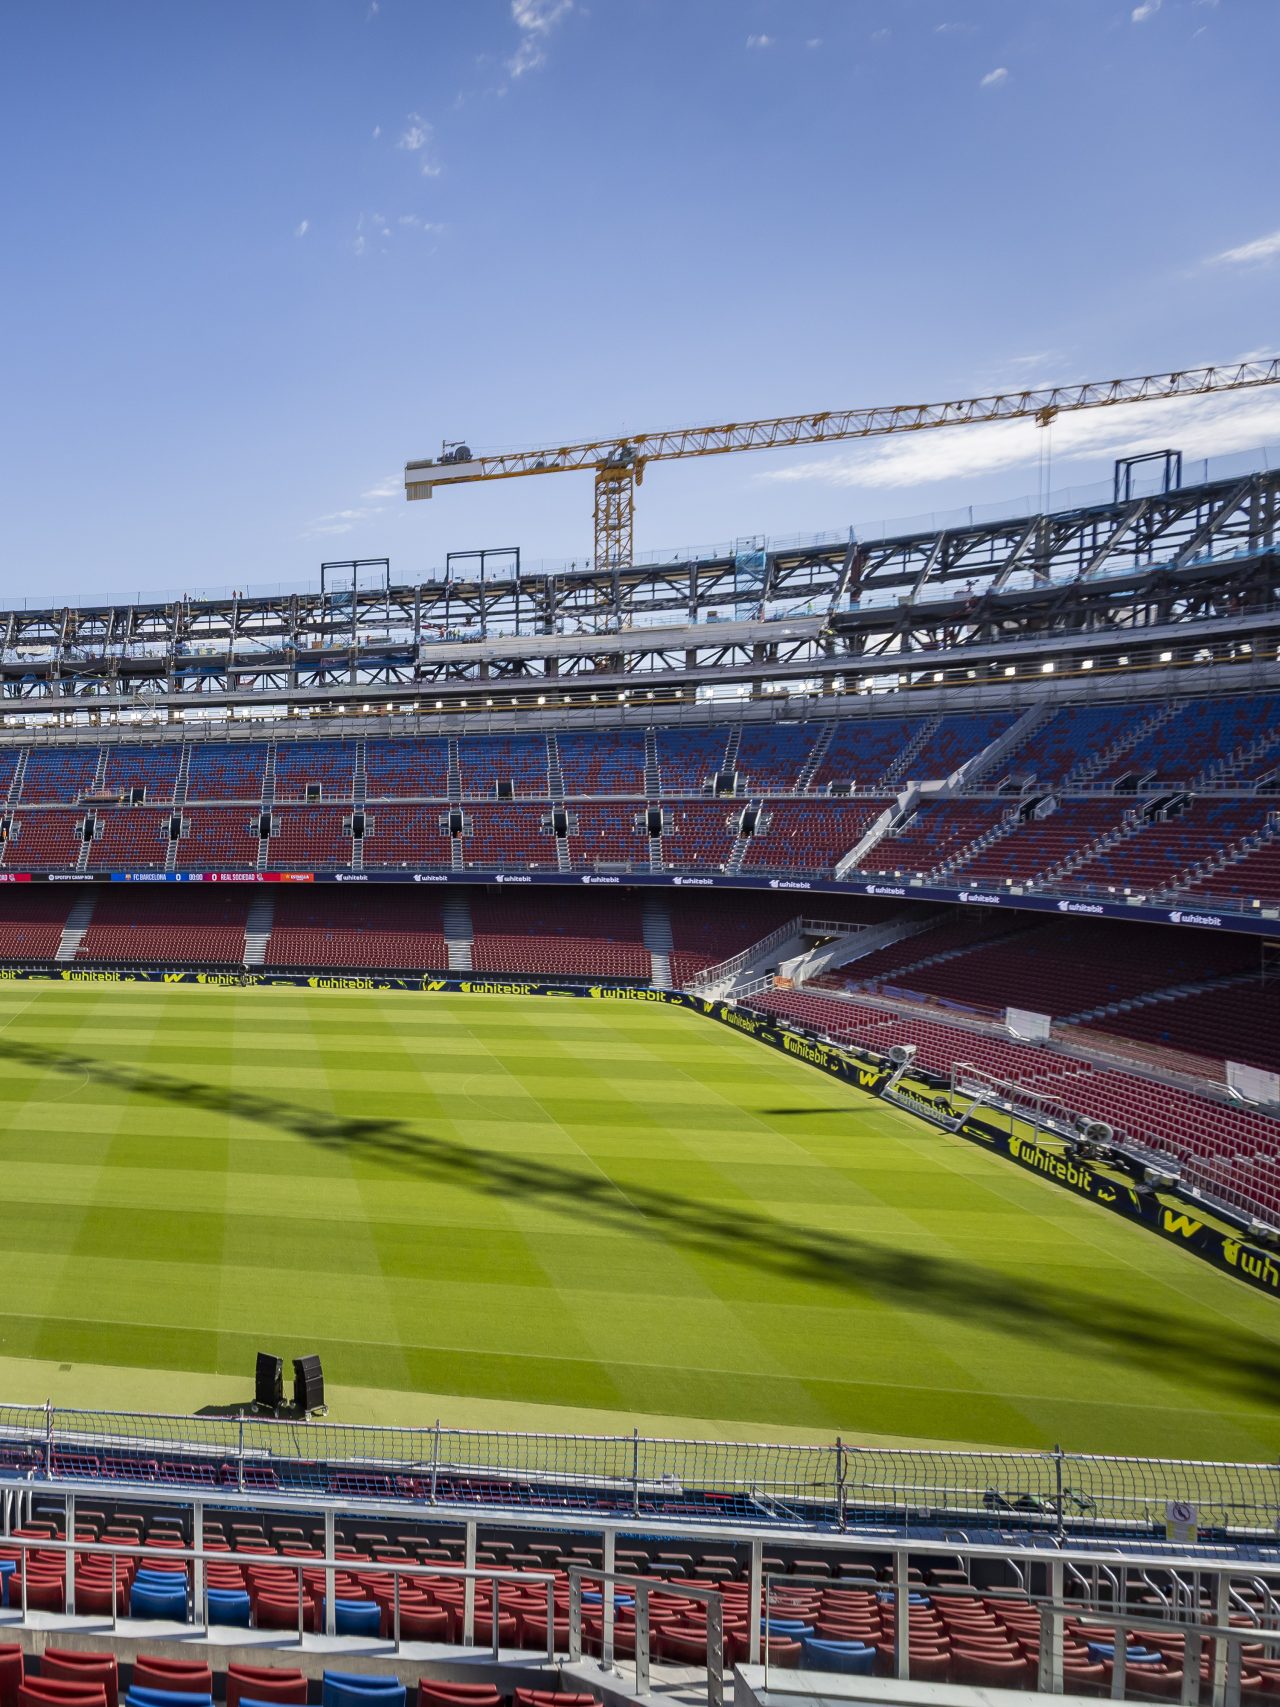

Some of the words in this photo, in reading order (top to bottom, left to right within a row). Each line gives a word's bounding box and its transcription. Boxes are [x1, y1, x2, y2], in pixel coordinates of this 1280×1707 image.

[682, 877, 713, 885] whitebit
[779, 880, 810, 889] whitebit
[875, 885, 905, 895] whitebit
[968, 892, 1000, 904] whitebit
[1067, 902, 1103, 914] whitebit
[1181, 913, 1221, 926] whitebit
[71, 971, 120, 982] whitebit
[319, 977, 374, 989] whitebit
[472, 981, 531, 995] whitebit
[603, 989, 666, 1002] whitebit
[728, 1013, 755, 1033] whitebit
[789, 1039, 828, 1066] whitebit
[1021, 1145, 1092, 1190] whitebit
